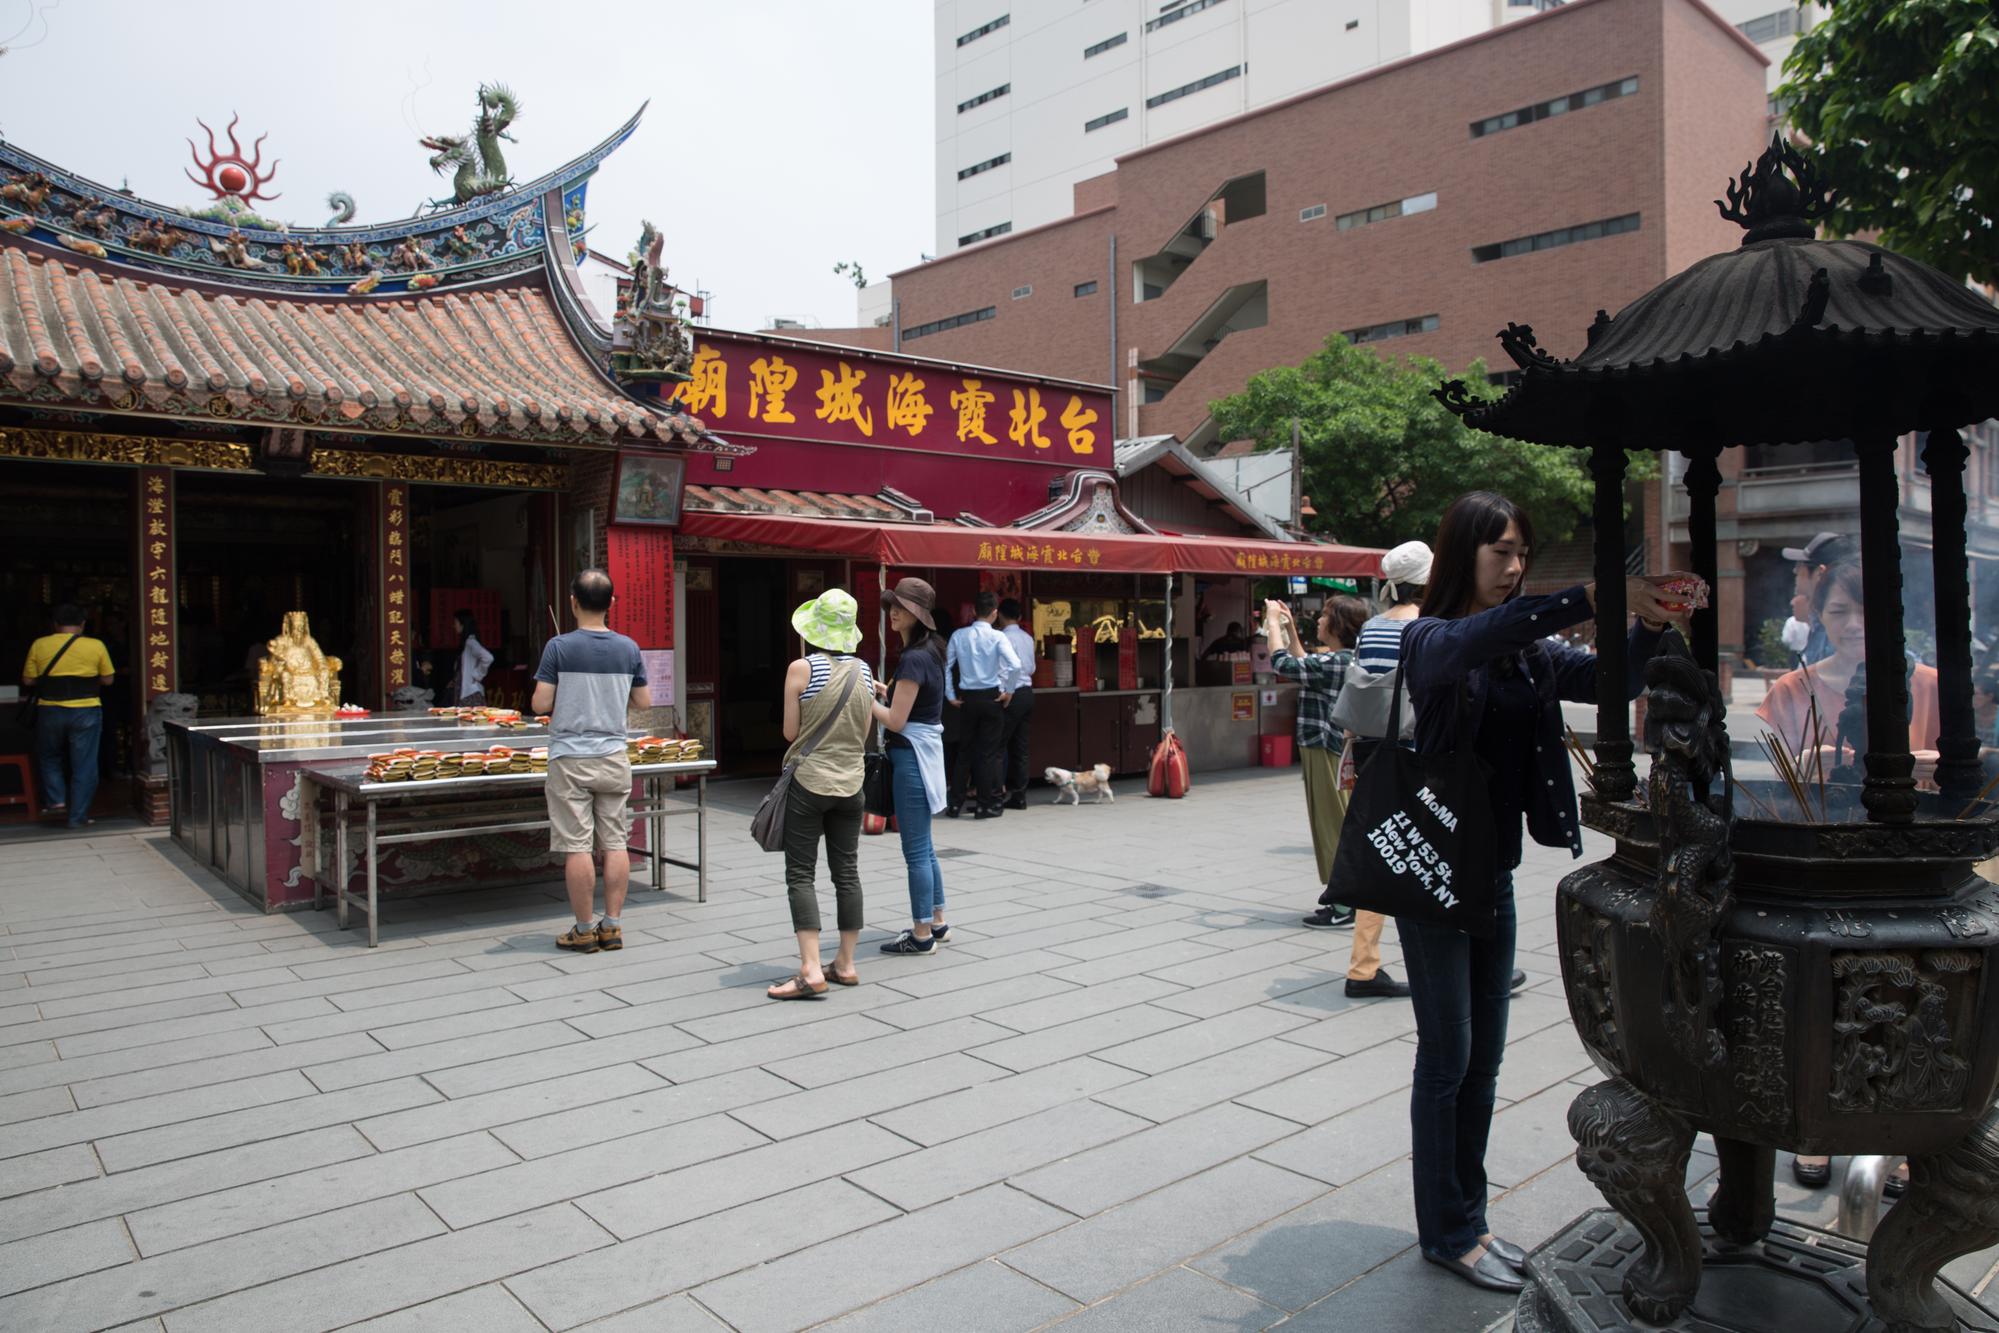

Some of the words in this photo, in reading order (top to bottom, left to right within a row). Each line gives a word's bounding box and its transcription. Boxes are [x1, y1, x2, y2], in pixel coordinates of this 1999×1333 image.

[673, 344, 1099, 455] 台北霞海城隍廟
[1415, 786, 1459, 833] MoMA
[1366, 828, 1408, 875] 10019
[1380, 818, 1408, 851] New
[1405, 850, 1434, 890] York,
[1433, 884, 1460, 909] NY
[1392, 810, 1412, 830] 11
[1406, 826, 1425, 846] W
[1418, 842, 1440, 865] 53
[1434, 861, 1455, 885] St.
